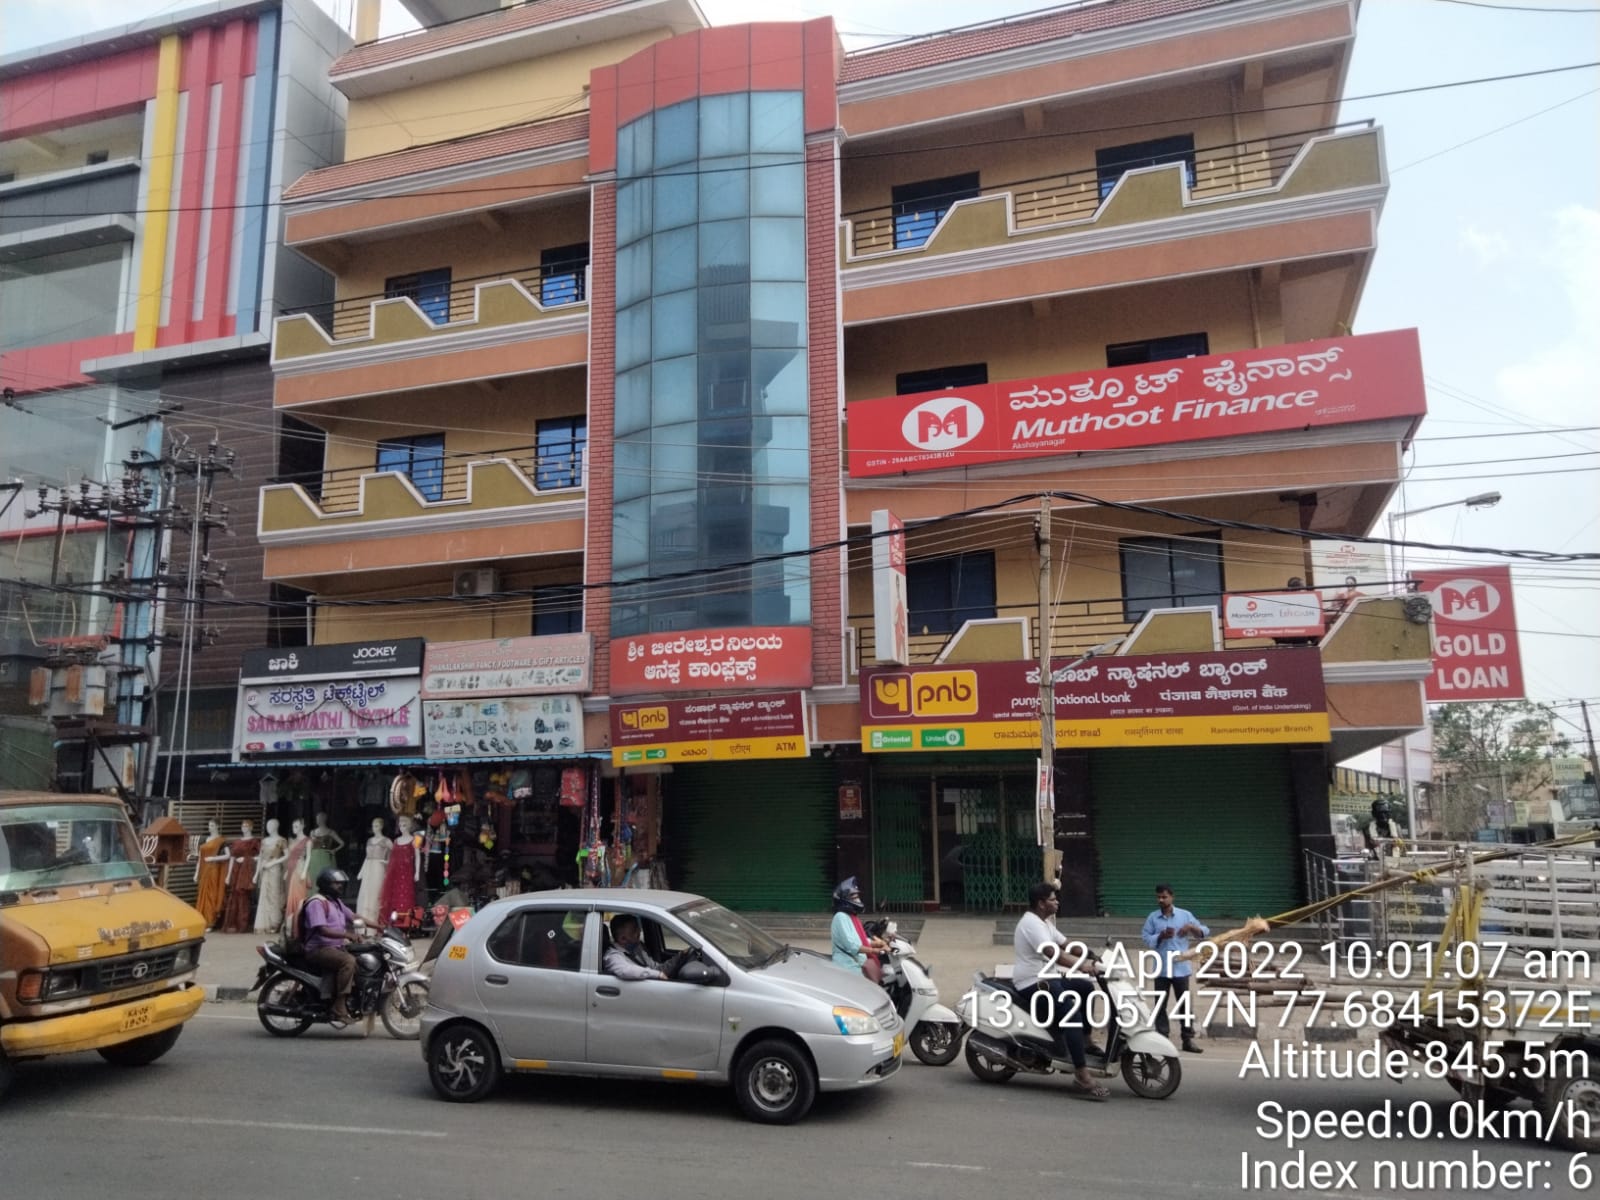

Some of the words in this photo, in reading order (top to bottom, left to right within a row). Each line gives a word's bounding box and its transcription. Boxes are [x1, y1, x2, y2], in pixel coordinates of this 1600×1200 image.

[1203, 347, 1353, 396] ಫೈನಾನ್ಸ್
[1012, 406, 1164, 440] Muthoot
[1172, 389, 1319, 422] Finance
[1012, 438, 1066, 450] Akshayanagar
[353, 646, 397, 659] JOCKEY
[627, 641, 645, 661] ಶ್ರೀ
[727, 633, 783, 652] ನಿಲಯ
[1435, 633, 1506, 657] GOLD
[268, 653, 299, 671] ಜಾಕಿ
[539, 655, 553, 665] GIFT
[555, 654, 585, 664] ARTICLES
[1025, 666, 1098, 684] ಪಜಾಬ್
[1107, 661, 1190, 688] ನ್ಯಾಷನಲ್
[1200, 658, 1267, 685] ಬ್ಯಾಂಕ್
[1438, 666, 1509, 690] LOAN
[269, 687, 315, 711] ಸರಸ್ವತಿ
[917, 676, 972, 710] pnb
[1053, 692, 1100, 705] national
[1102, 692, 1131, 704] bank
[1160, 688, 1201, 701] पंजाब
[1262, 683, 1288, 698] बैंक
[247, 710, 344, 732] SARASWATHI
[350, 706, 410, 728] TEXTILE
[641, 711, 666, 725] pnb
[882, 735, 911, 743] Oriental
[925, 734, 945, 742] United
[1211, 727, 1282, 735] Ramamurthynagar
[1284, 725, 1313, 733] Branch
[776, 742, 797, 752] ATM
